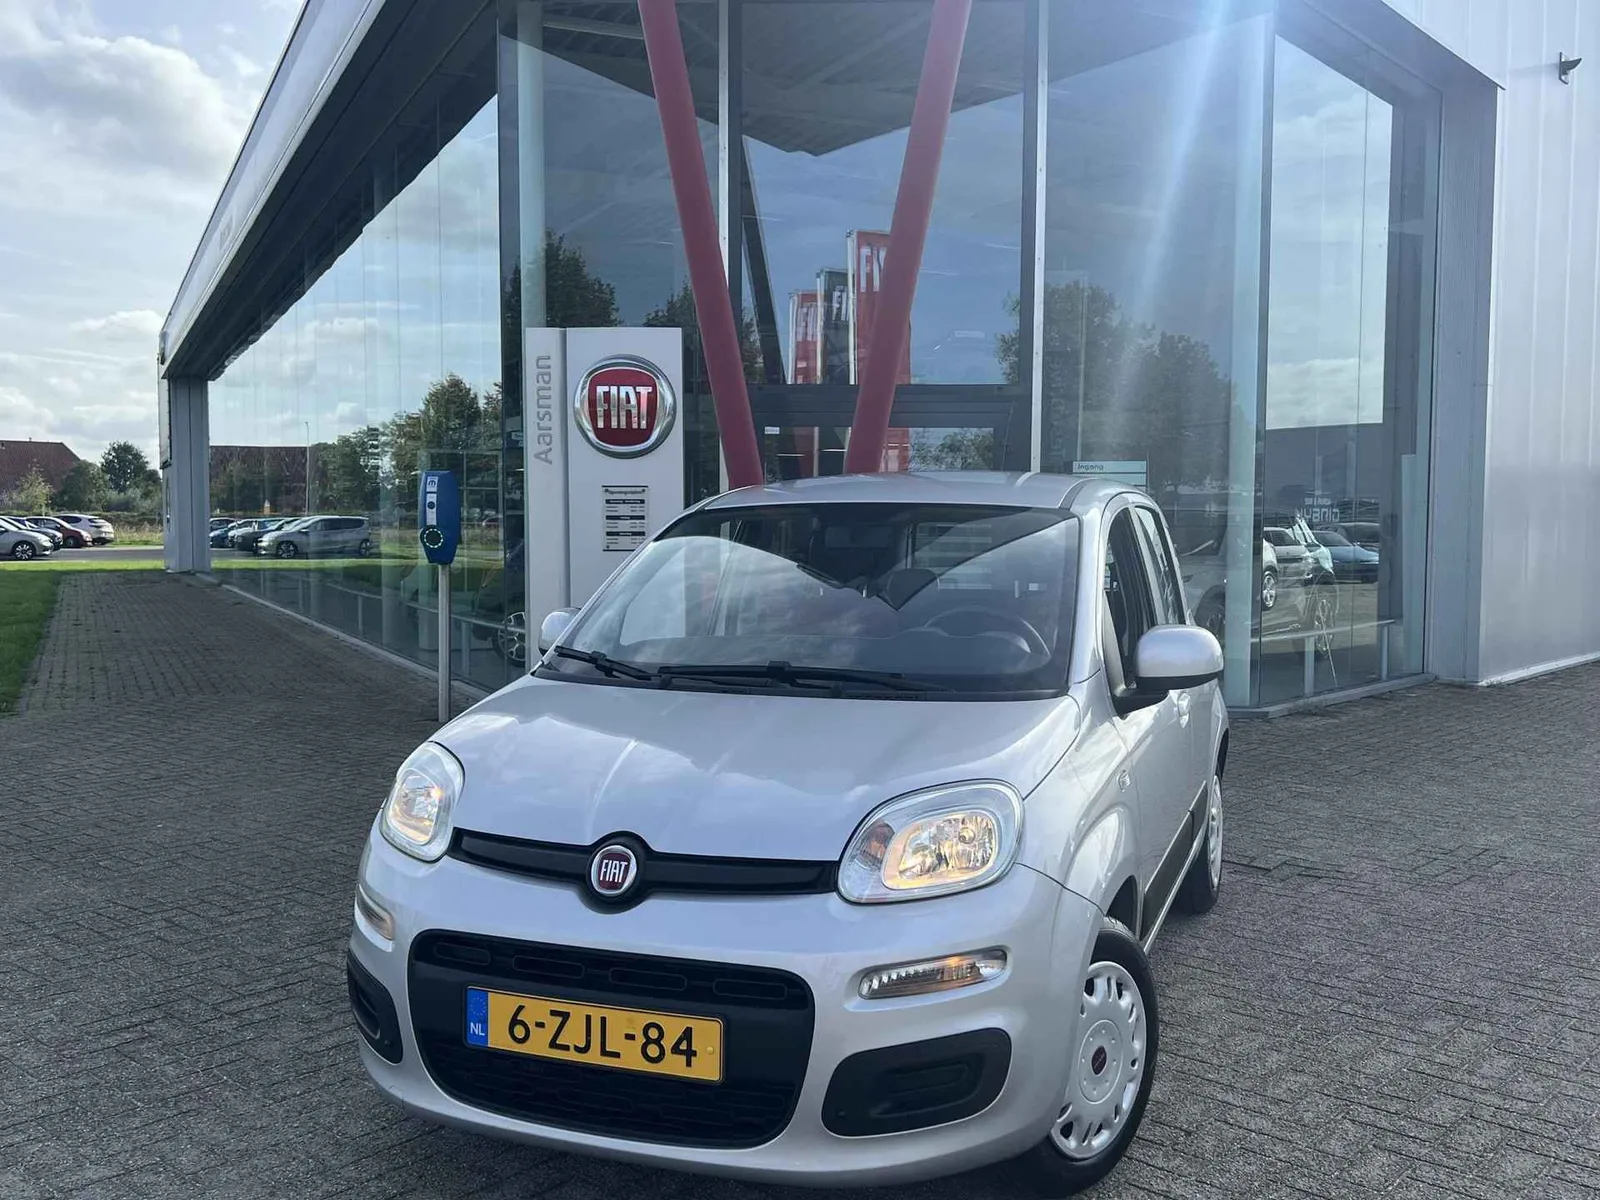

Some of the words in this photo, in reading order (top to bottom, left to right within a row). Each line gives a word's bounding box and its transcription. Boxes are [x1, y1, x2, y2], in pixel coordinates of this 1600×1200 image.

[533, 354, 553, 465] Aarsman
[595, 385, 652, 429] FIAT
[600, 859, 628, 883] FIAT
[470, 1022, 486, 1037] NL
[508, 1004, 697, 1068] 6-ZJL-84
